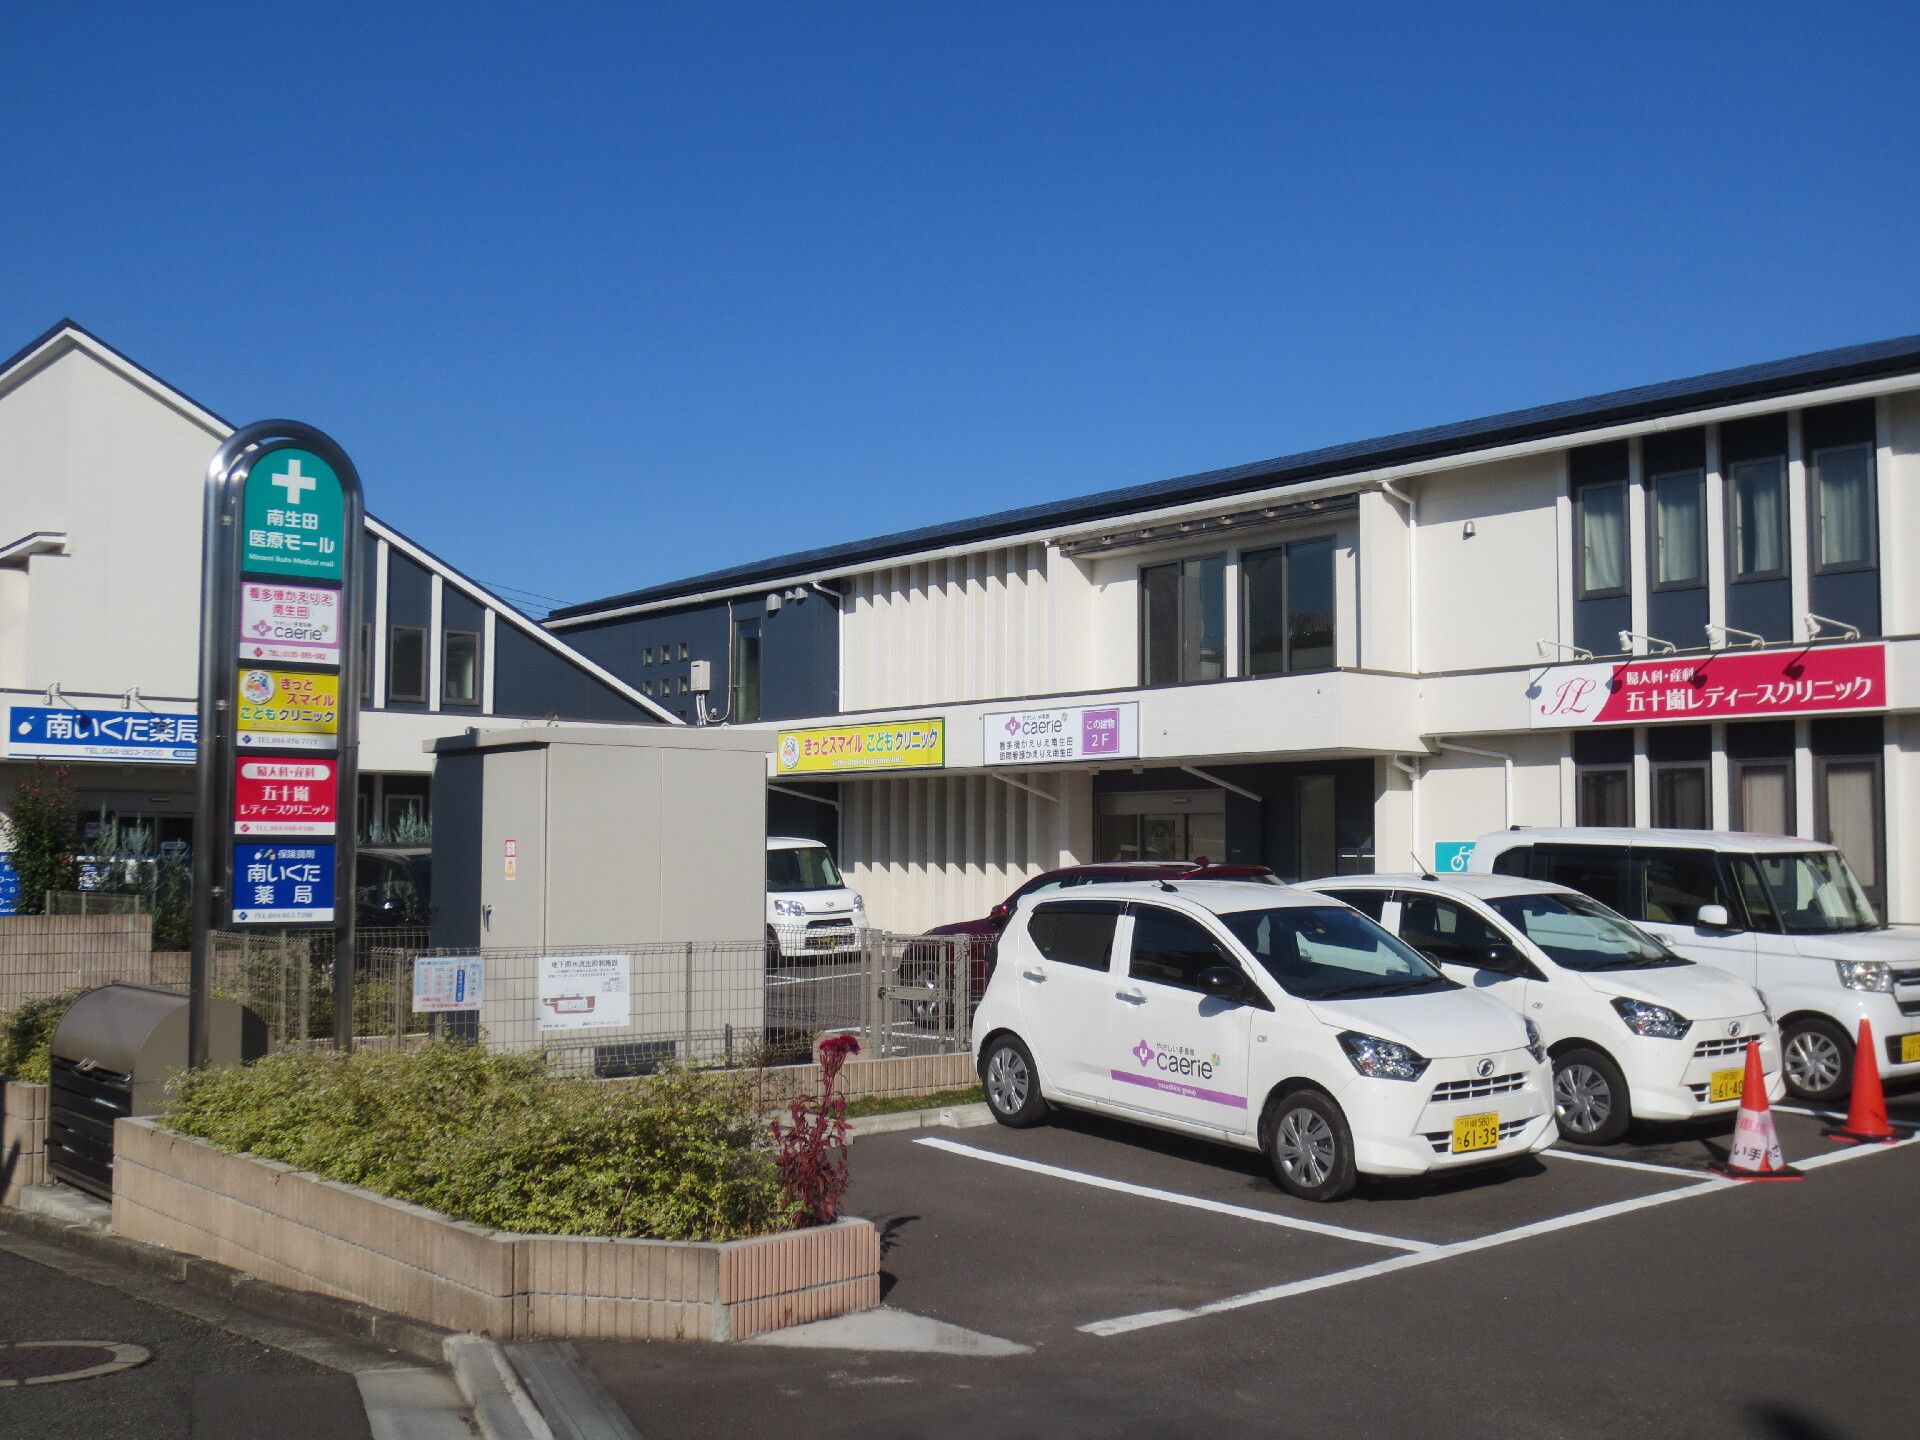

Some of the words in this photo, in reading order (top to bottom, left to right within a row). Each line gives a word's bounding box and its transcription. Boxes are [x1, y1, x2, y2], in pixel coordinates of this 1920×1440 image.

[267, 509, 318, 530] 南生田
[249, 529, 335, 553] 医療モール
[273, 604, 310, 618] 南生田
[274, 626, 322, 641] caerie
[281, 678, 314, 690] きっと
[1626, 666, 1695, 686] 婦人科・産科
[286, 693, 335, 706] スマイル
[1626, 676, 1872, 713] 五十嵐レディースクリニック
[240, 707, 335, 723] こどもクリニック
[46, 712, 198, 743] 南いくた薬局
[1022, 719, 1063, 736] caerie
[804, 734, 863, 756] きっとスマイル
[261, 785, 311, 802] 五十嵐
[240, 804, 330, 816] レディースクリニック
[247, 863, 321, 883] 南いくた
[1156, 1052, 1213, 1080] caerie
